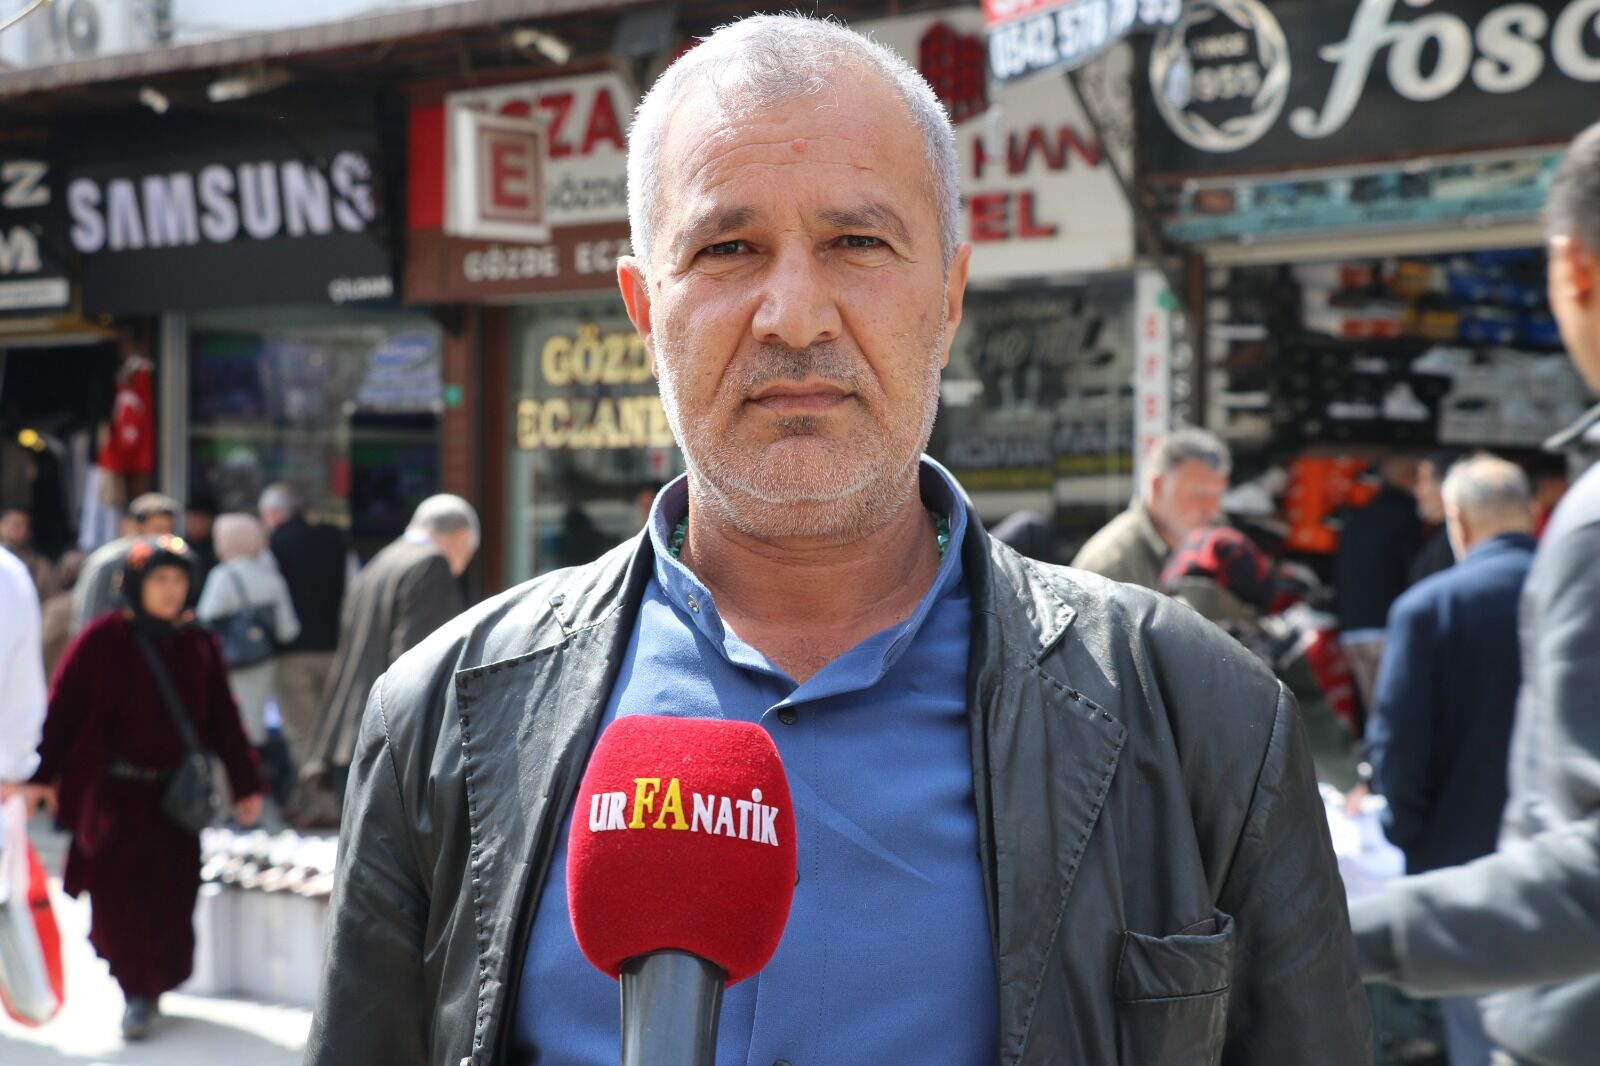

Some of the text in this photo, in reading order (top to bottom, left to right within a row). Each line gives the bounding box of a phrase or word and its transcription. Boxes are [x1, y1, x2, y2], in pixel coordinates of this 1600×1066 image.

[66, 151, 375, 253] SAMSUNG
[960, 189, 1058, 242] EL
[588, 777, 780, 847] URFANATİK
